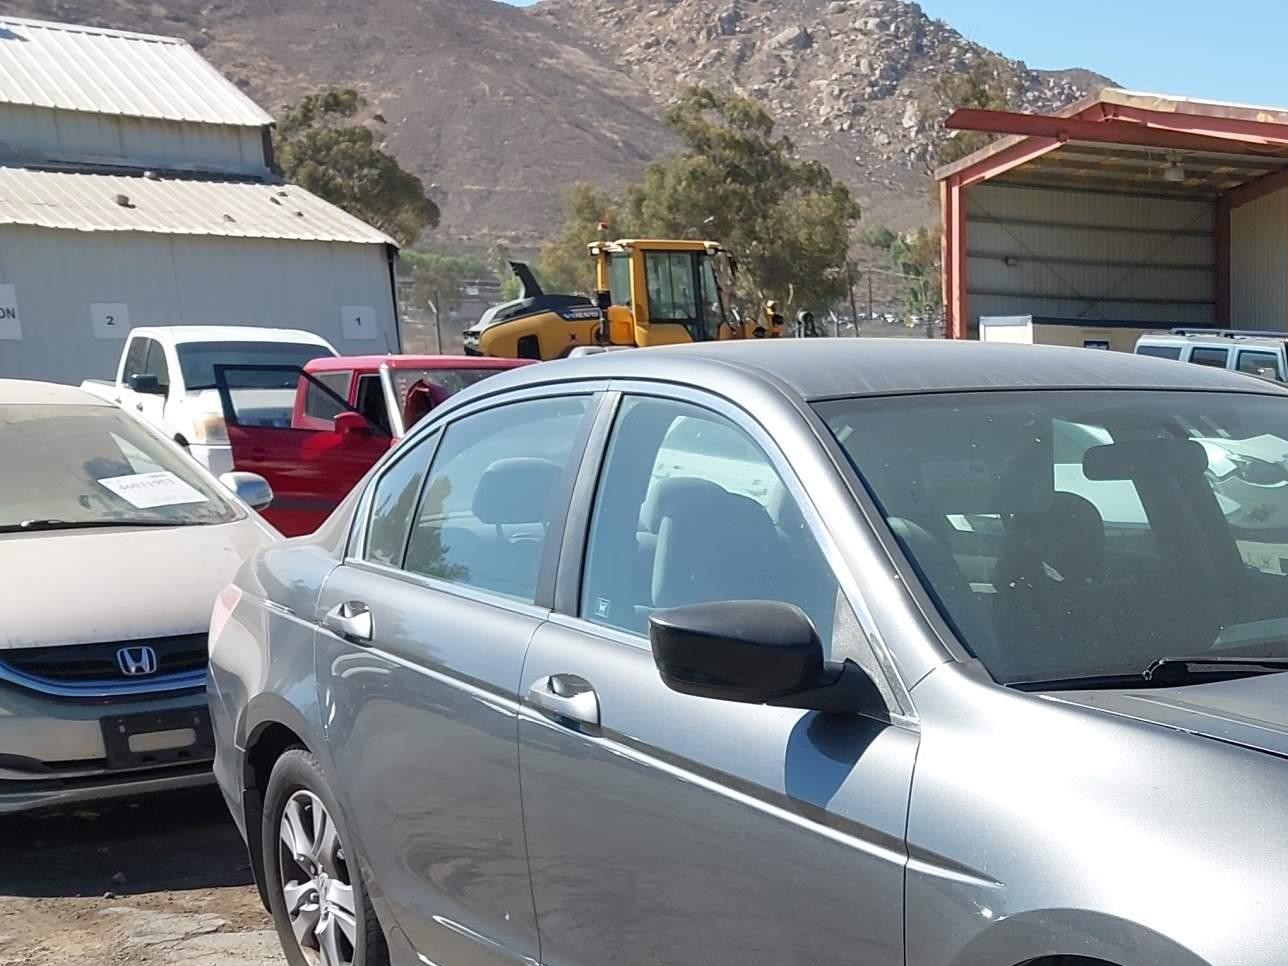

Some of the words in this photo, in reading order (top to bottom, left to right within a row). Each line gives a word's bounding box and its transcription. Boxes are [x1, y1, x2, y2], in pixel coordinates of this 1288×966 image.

[105, 315, 115, 325] 2
[562, 311, 599, 319] VOLVO
[354, 316, 361, 326] 1
